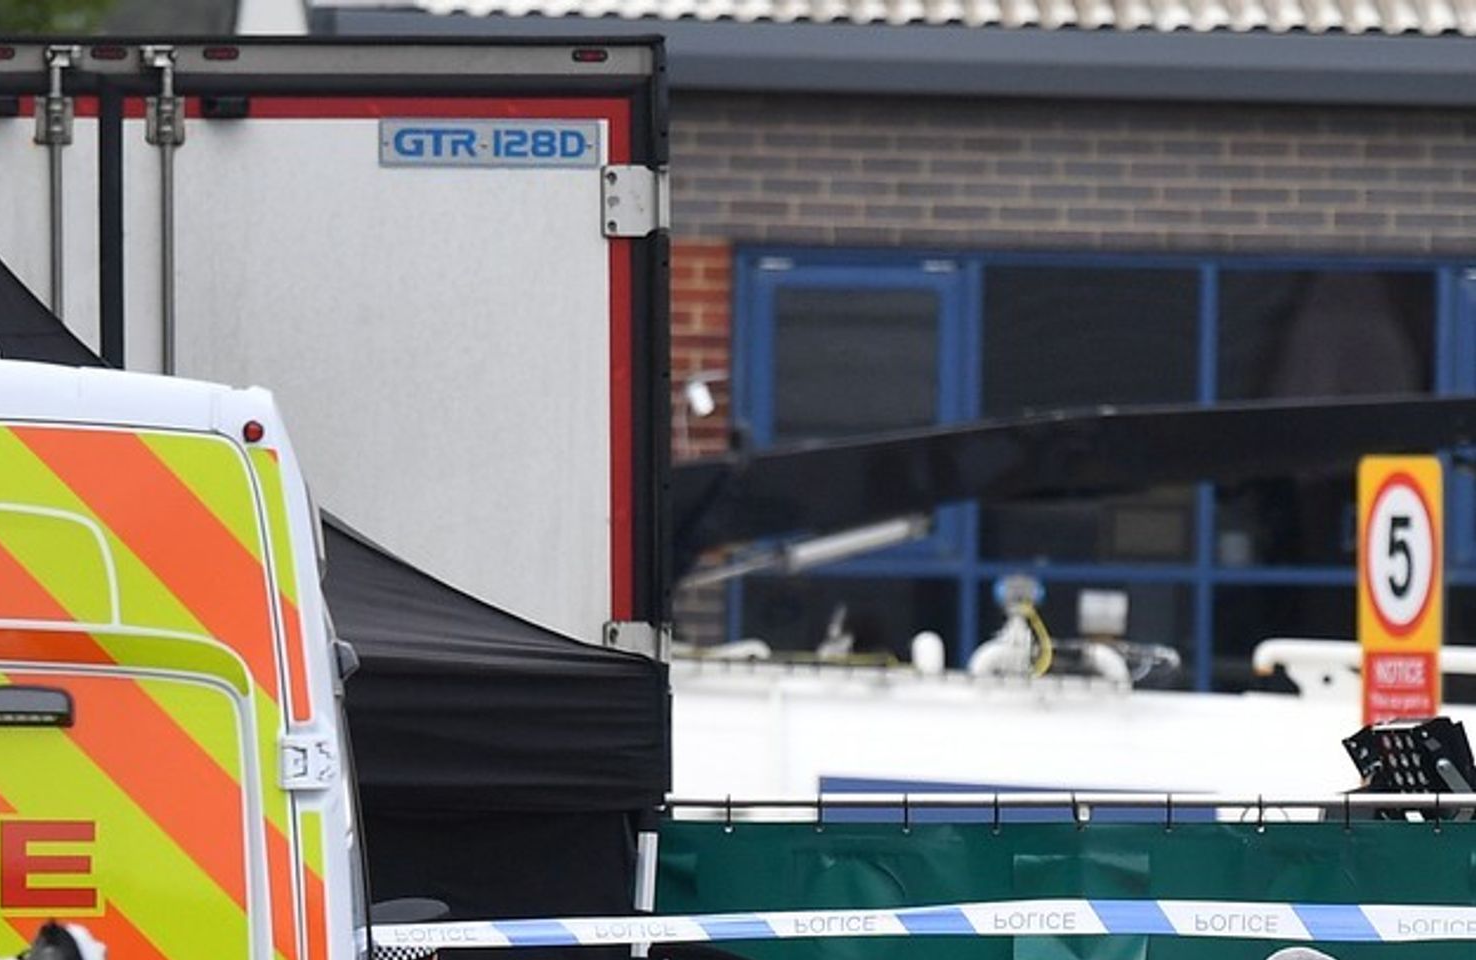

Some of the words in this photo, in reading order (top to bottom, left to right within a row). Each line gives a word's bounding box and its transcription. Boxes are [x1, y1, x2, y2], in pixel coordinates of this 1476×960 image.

[393, 127, 477, 158] GTR
[493, 129, 586, 158] 128D
[1387, 516, 1413, 598] 5
